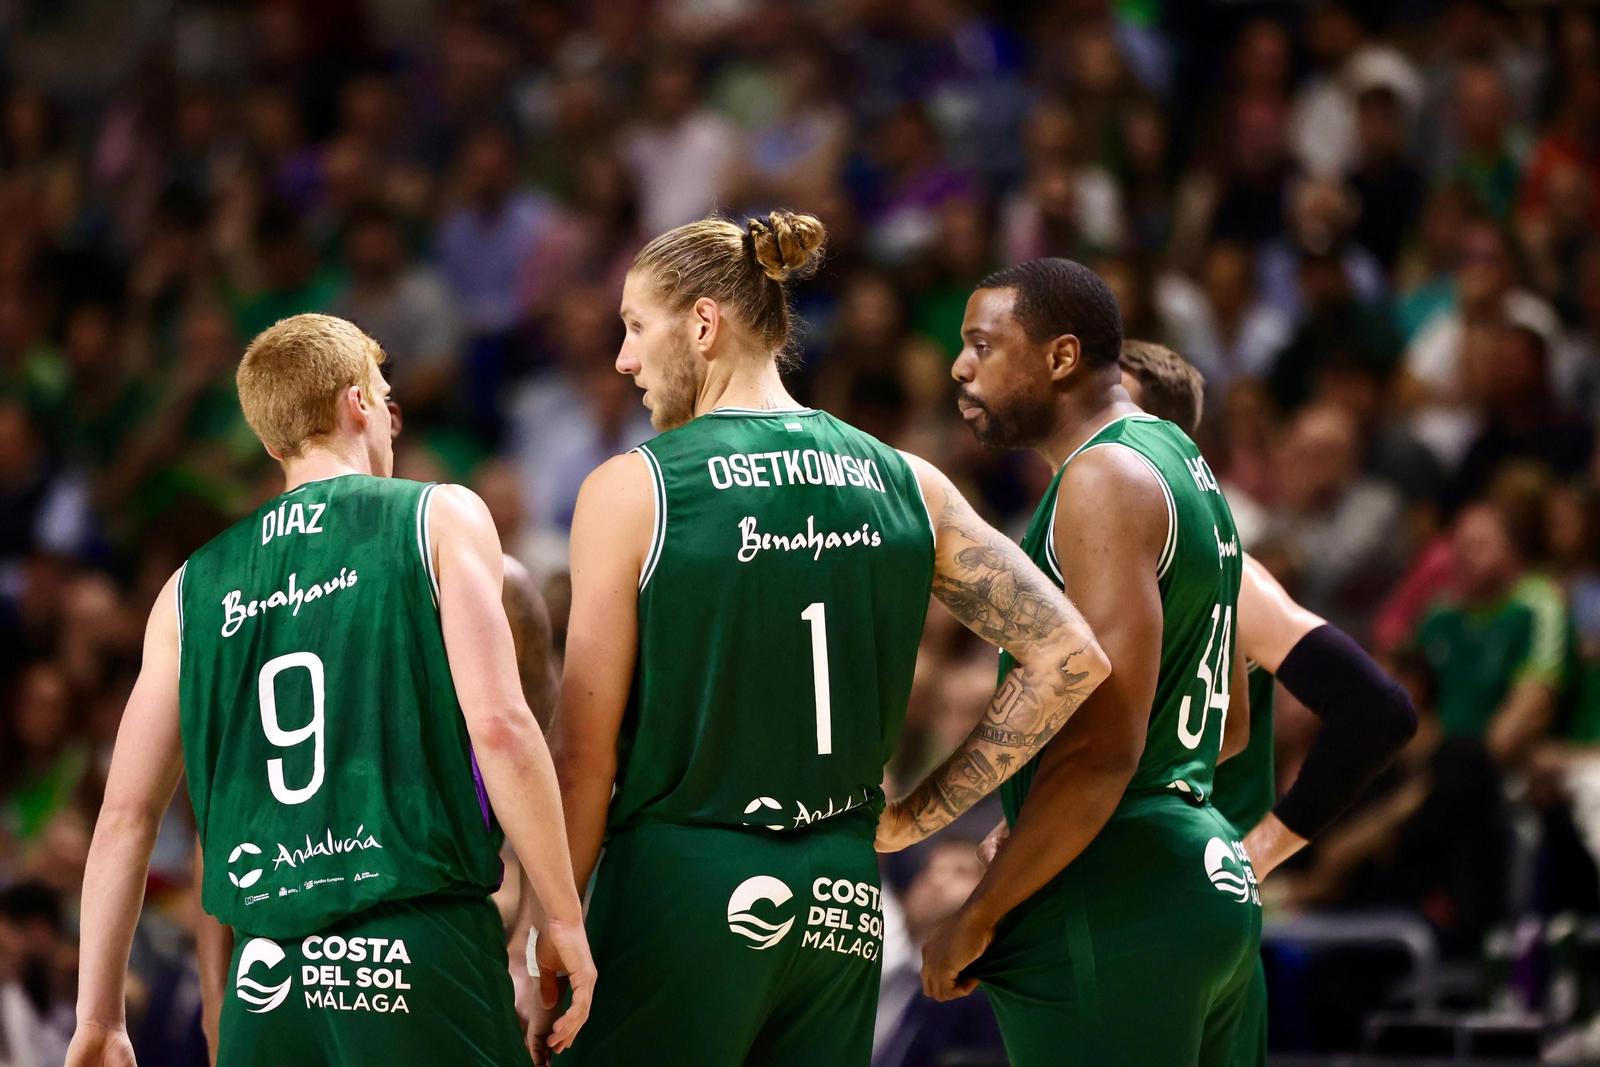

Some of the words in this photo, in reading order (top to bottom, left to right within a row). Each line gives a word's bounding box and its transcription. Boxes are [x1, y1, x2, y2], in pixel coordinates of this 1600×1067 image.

[707, 449, 887, 494] OSETKOWSKI
[261, 500, 327, 546] DÍAZ
[737, 515, 882, 563] Benahavis
[800, 602, 832, 755] 1
[1177, 603, 1232, 751] 34
[258, 651, 326, 805] 9
[272, 824, 383, 871] Andalucía
[807, 906, 854, 930] DEL
[857, 912, 883, 941] SOL
[301, 935, 412, 964] COSTA
[301, 965, 350, 986] DEL
[355, 966, 411, 990] SOL
[304, 986, 410, 1014] MÁLAGA
